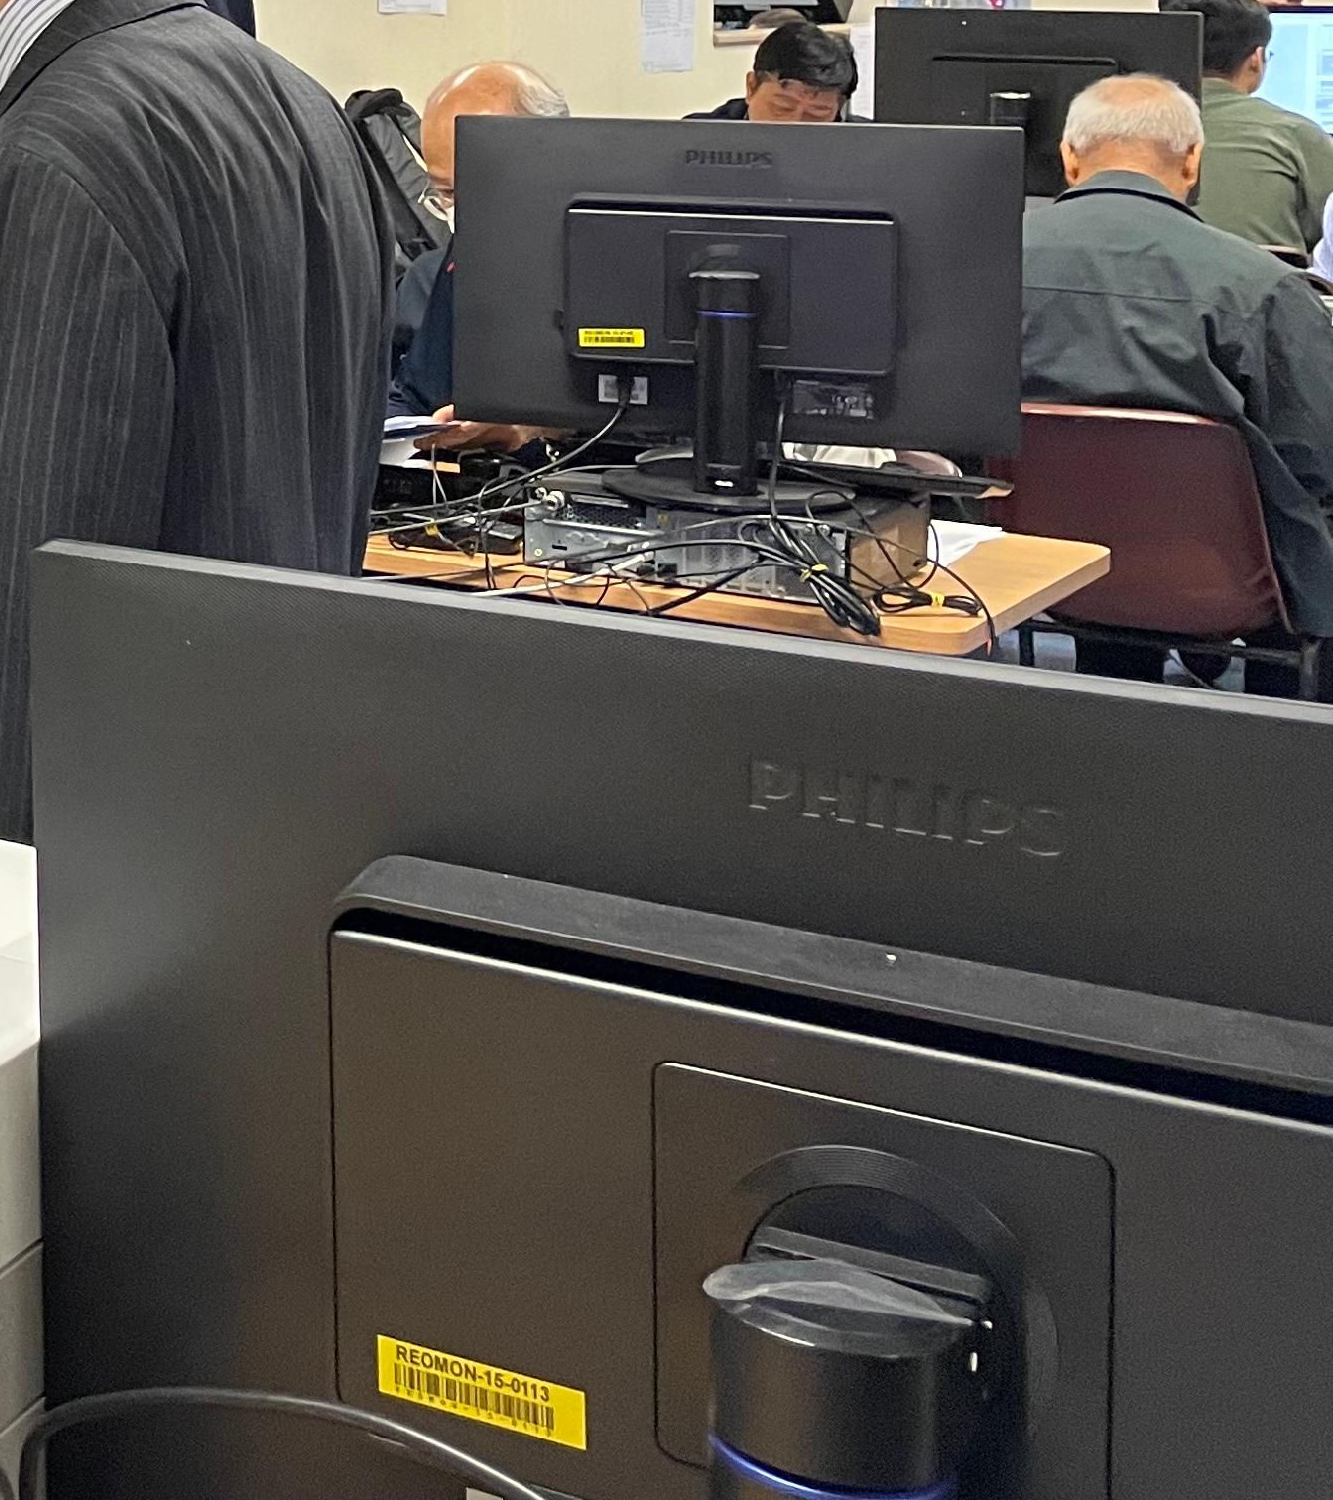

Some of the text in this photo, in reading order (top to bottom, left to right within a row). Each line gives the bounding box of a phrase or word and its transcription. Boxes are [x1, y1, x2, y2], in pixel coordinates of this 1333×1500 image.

[685, 149, 773, 167] PHILIPS
[748, 758, 1063, 858] PHILIPS
[395, 1343, 551, 1402] REOMON-15-0113
